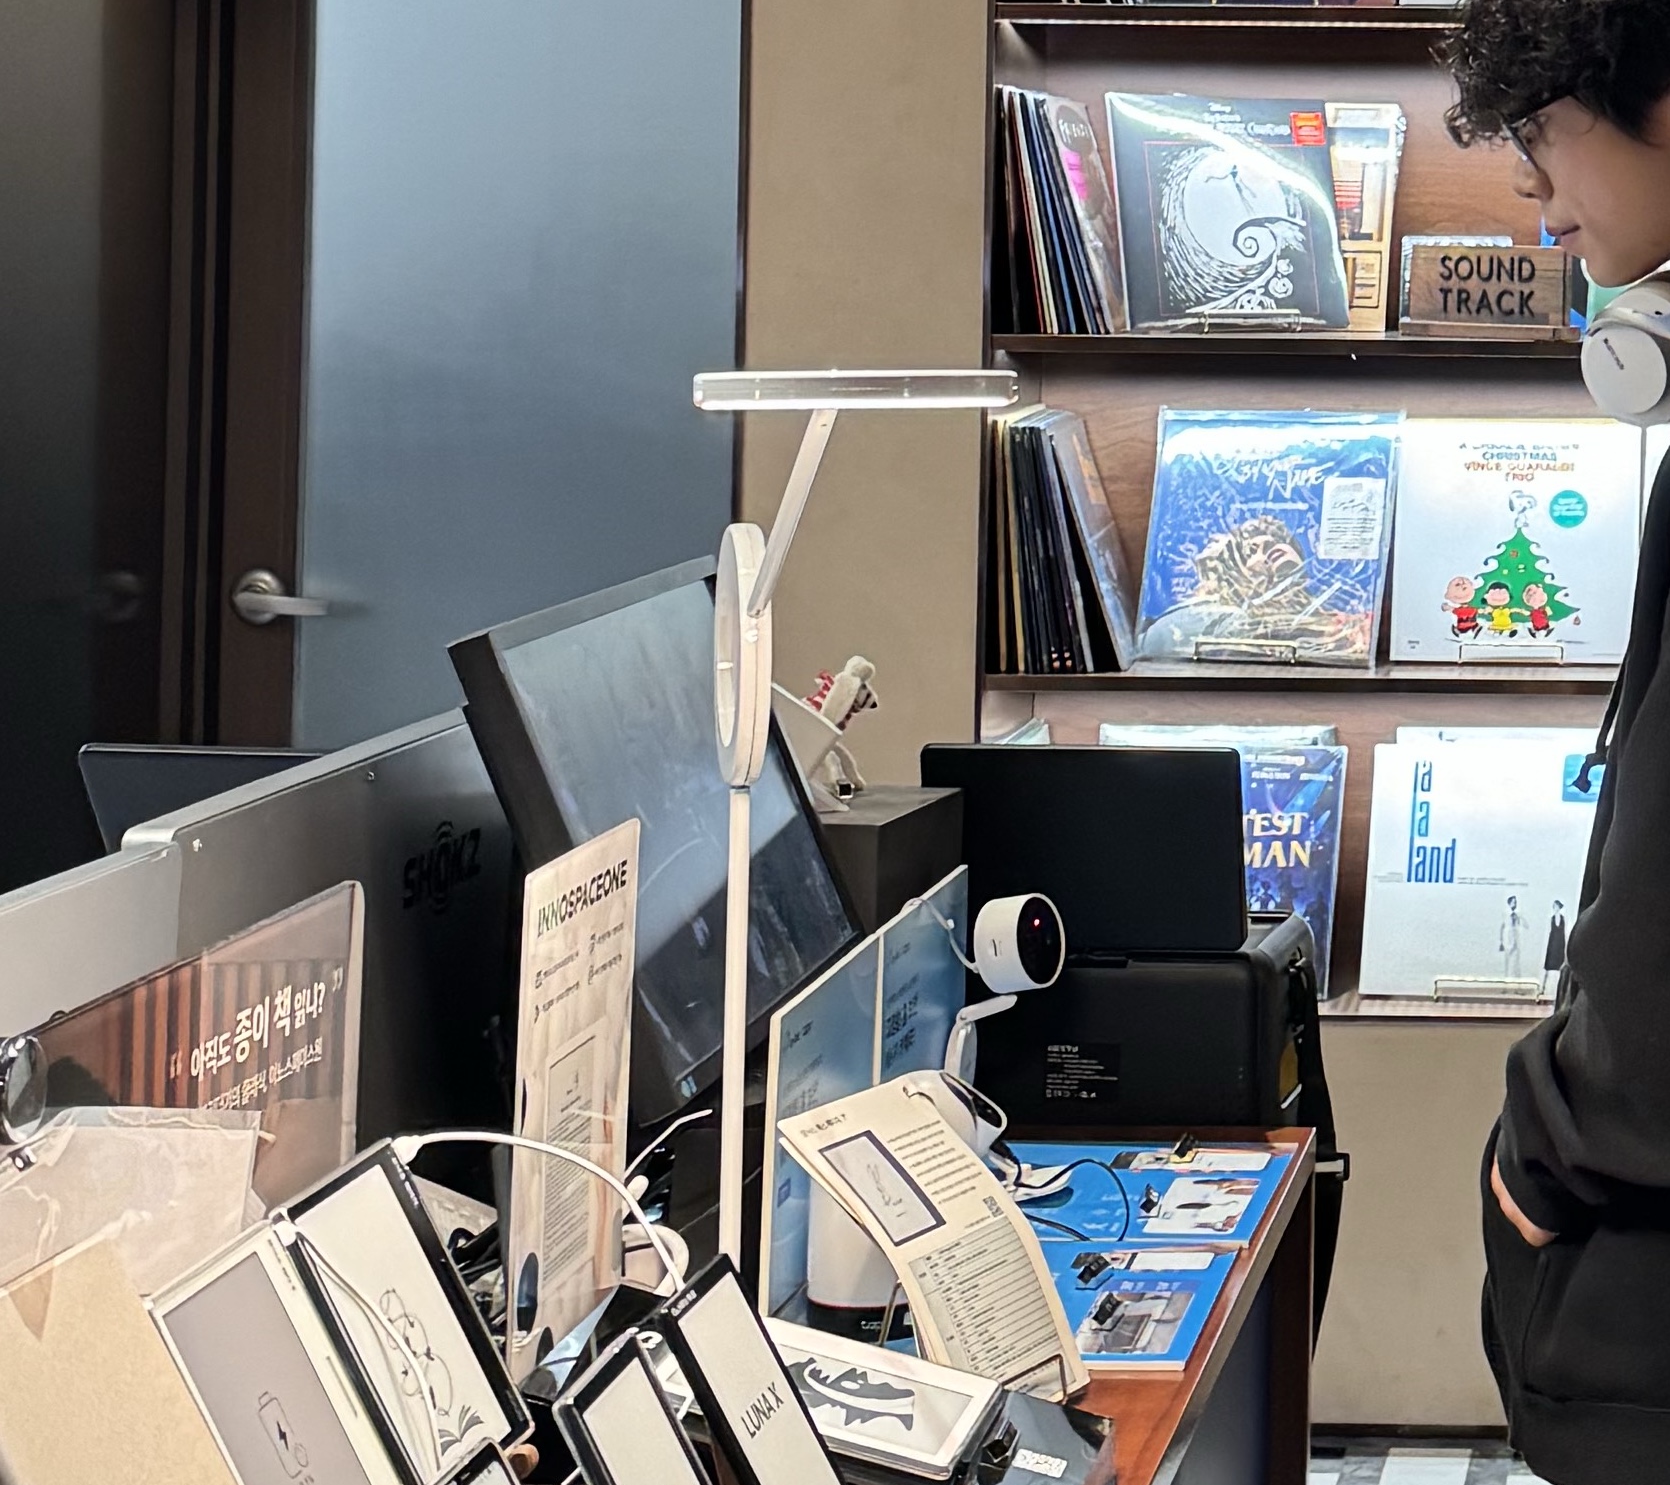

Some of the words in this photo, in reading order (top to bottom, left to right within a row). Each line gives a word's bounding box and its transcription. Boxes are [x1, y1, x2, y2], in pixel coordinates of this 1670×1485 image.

[1439, 255, 1536, 284] SOUND
[1438, 287, 1535, 317] TRACK
[537, 859, 628, 938] INNOSPACEONE
[190, 1032, 232, 1082] 아직도
[233, 996, 270, 1063] 종이
[273, 985, 292, 1037] 책
[741, 1393, 775, 1439] LUNA
[768, 1381, 785, 1408] X
